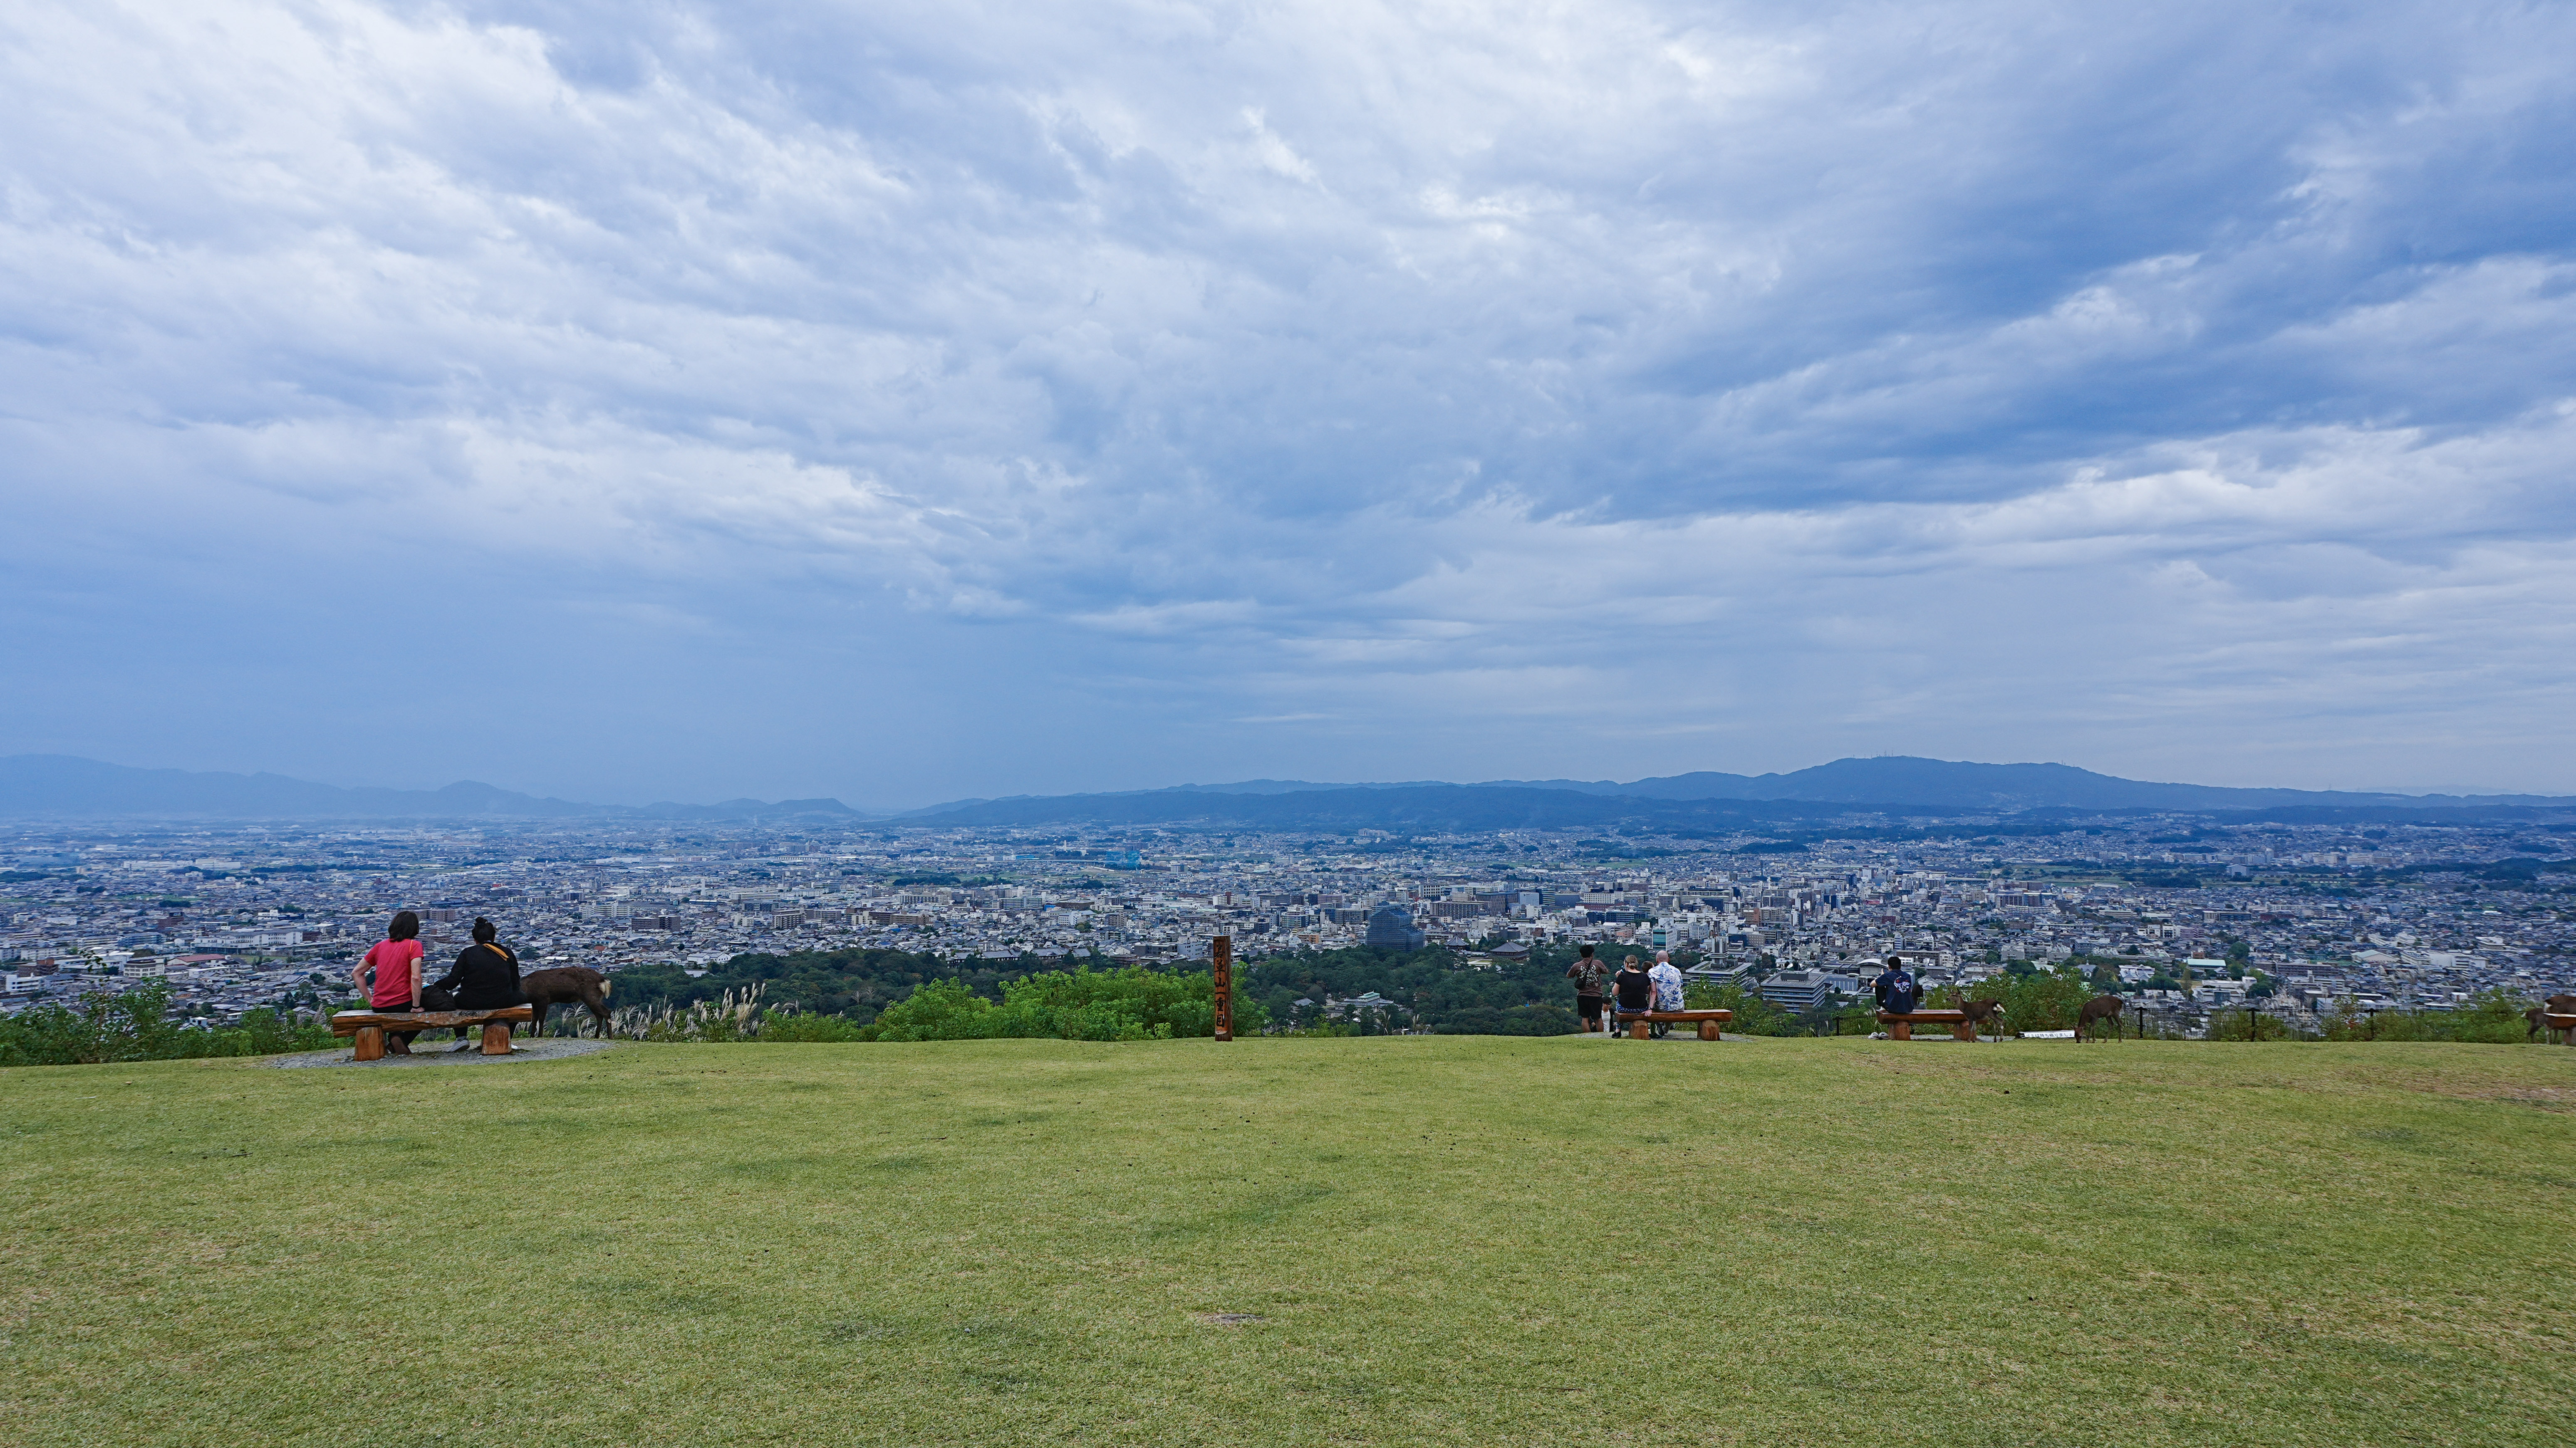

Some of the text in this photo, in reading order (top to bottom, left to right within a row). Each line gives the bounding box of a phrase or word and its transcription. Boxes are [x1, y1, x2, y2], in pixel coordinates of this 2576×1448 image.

[1214, 944, 1226, 1027] 若草山一重目
